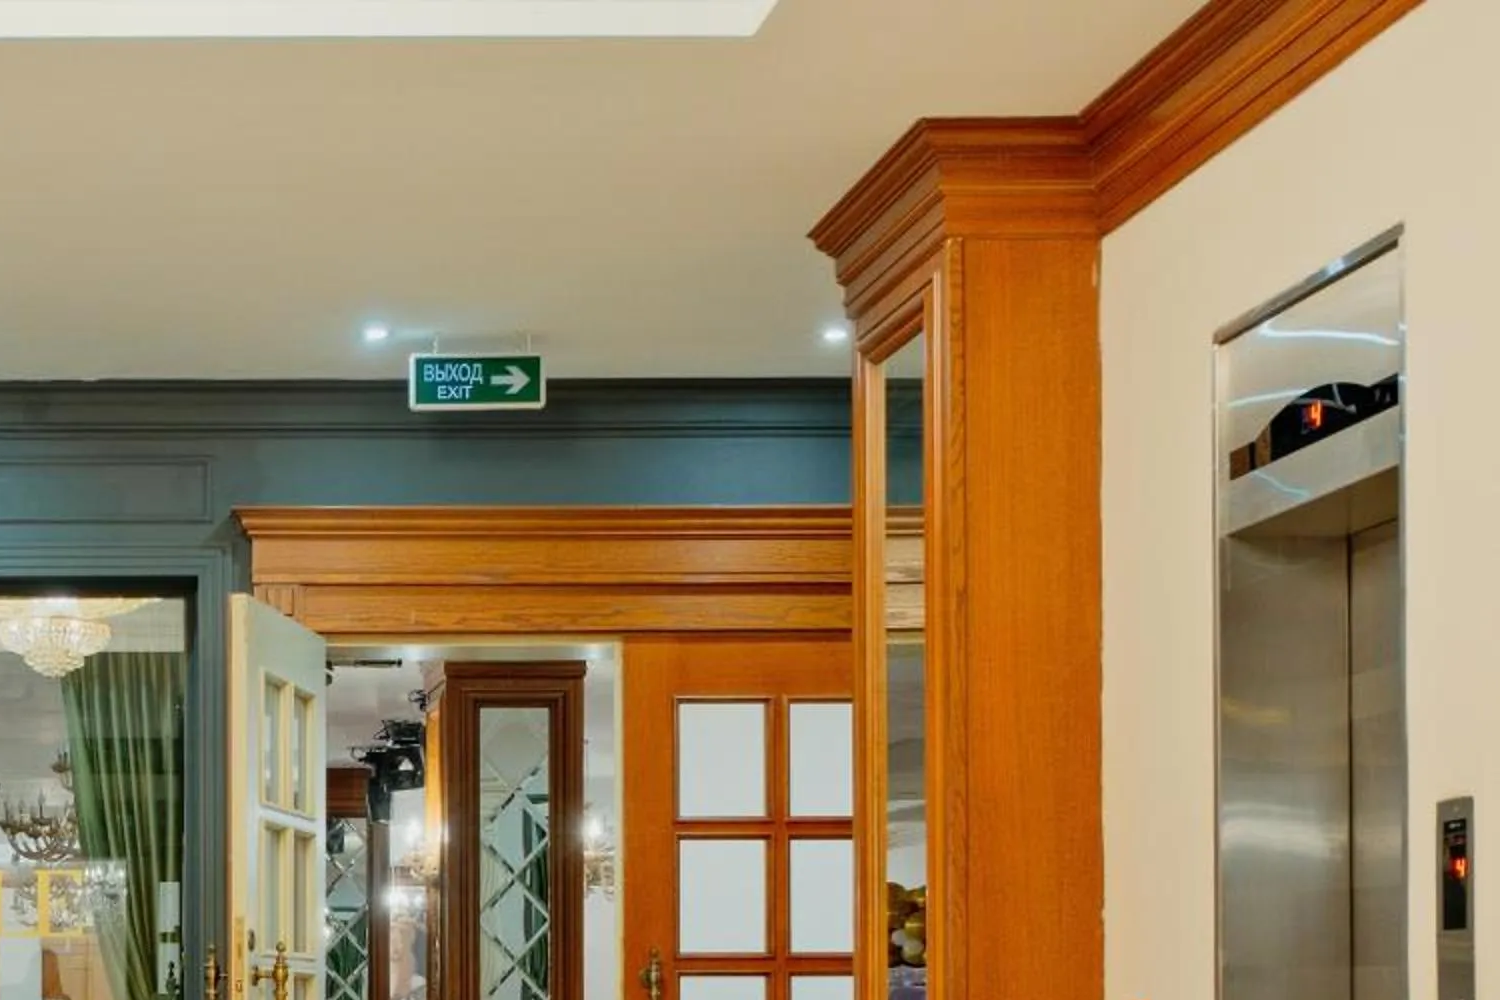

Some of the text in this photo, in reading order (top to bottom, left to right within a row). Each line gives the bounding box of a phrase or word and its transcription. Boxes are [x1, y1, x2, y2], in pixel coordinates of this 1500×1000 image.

[423, 363, 484, 385] ВЫХОД
[437, 385, 473, 400] EXIT
[1310, 399, 1323, 427] 4
[1455, 857, 1467, 880] 4
